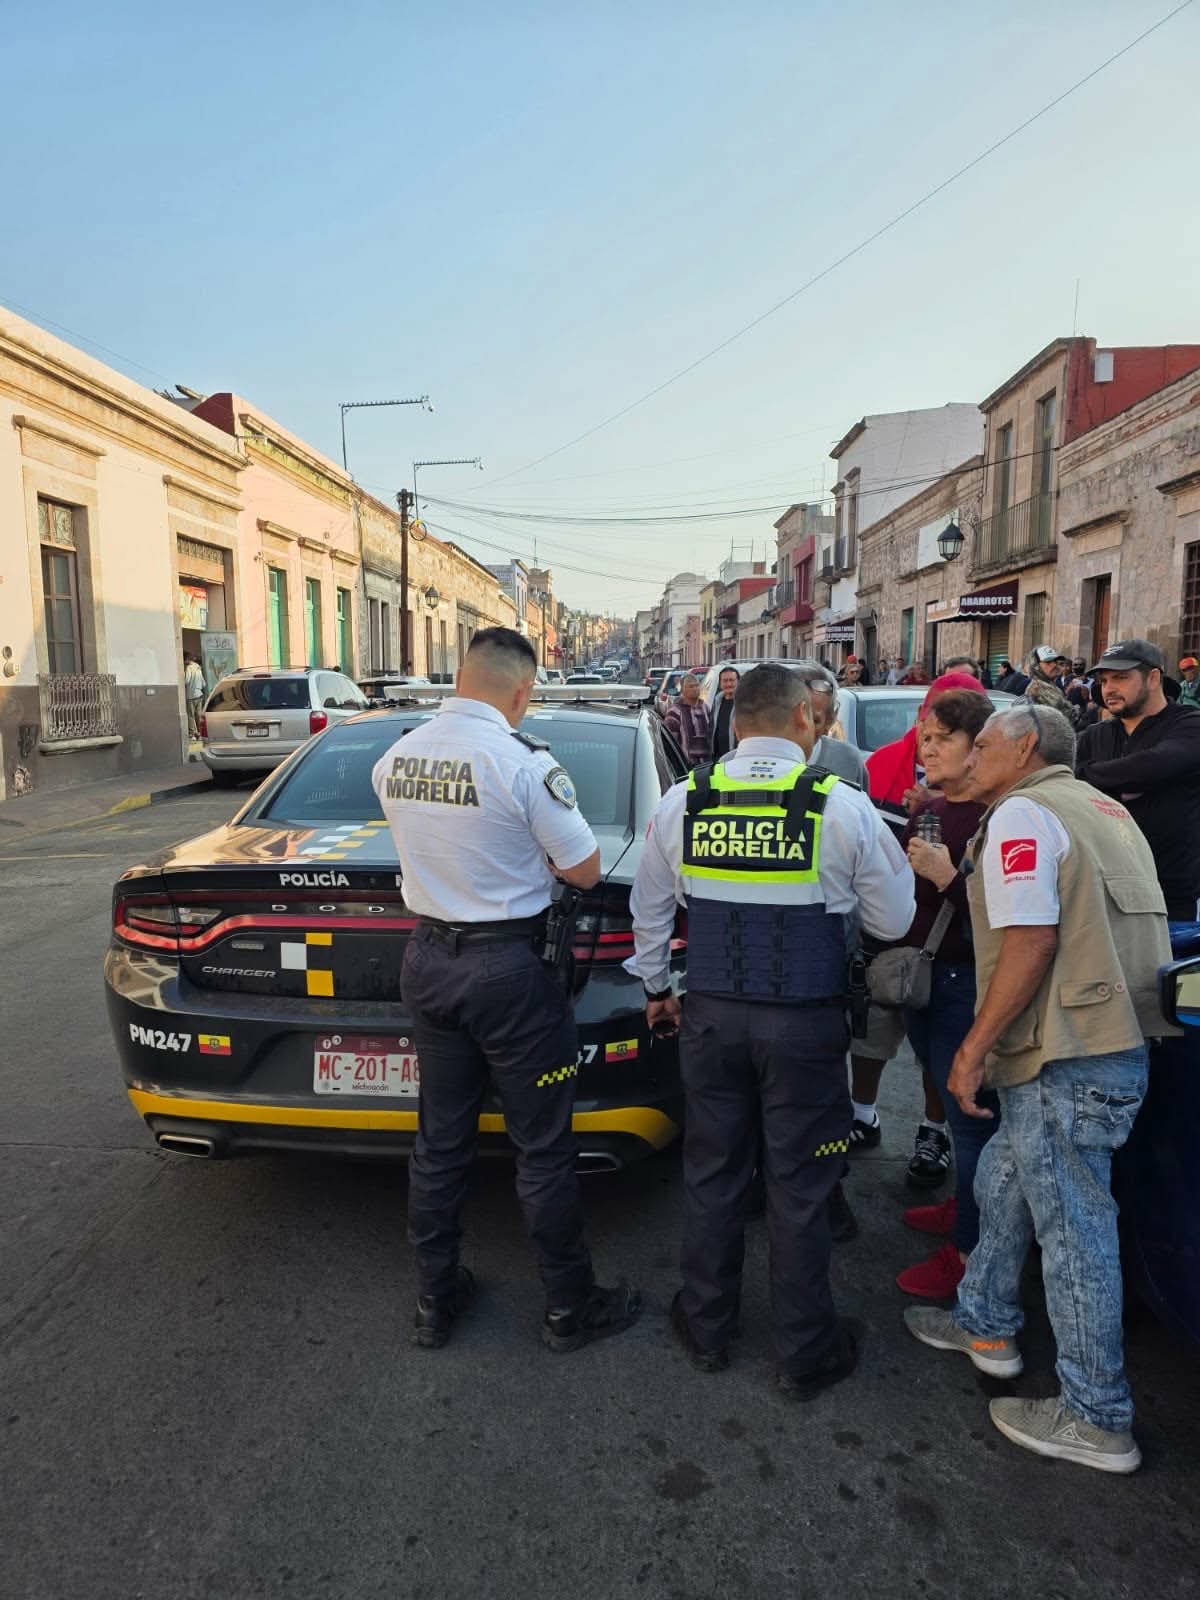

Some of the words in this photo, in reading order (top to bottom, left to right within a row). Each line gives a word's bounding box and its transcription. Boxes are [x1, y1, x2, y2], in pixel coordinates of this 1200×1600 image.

[386, 777, 479, 806] MORELIA
[692, 840, 805, 860] MORELIA
[280, 870, 350, 886] POLICÍA
[202, 966, 276, 978] CHARGER
[129, 1023, 192, 1052] PM247
